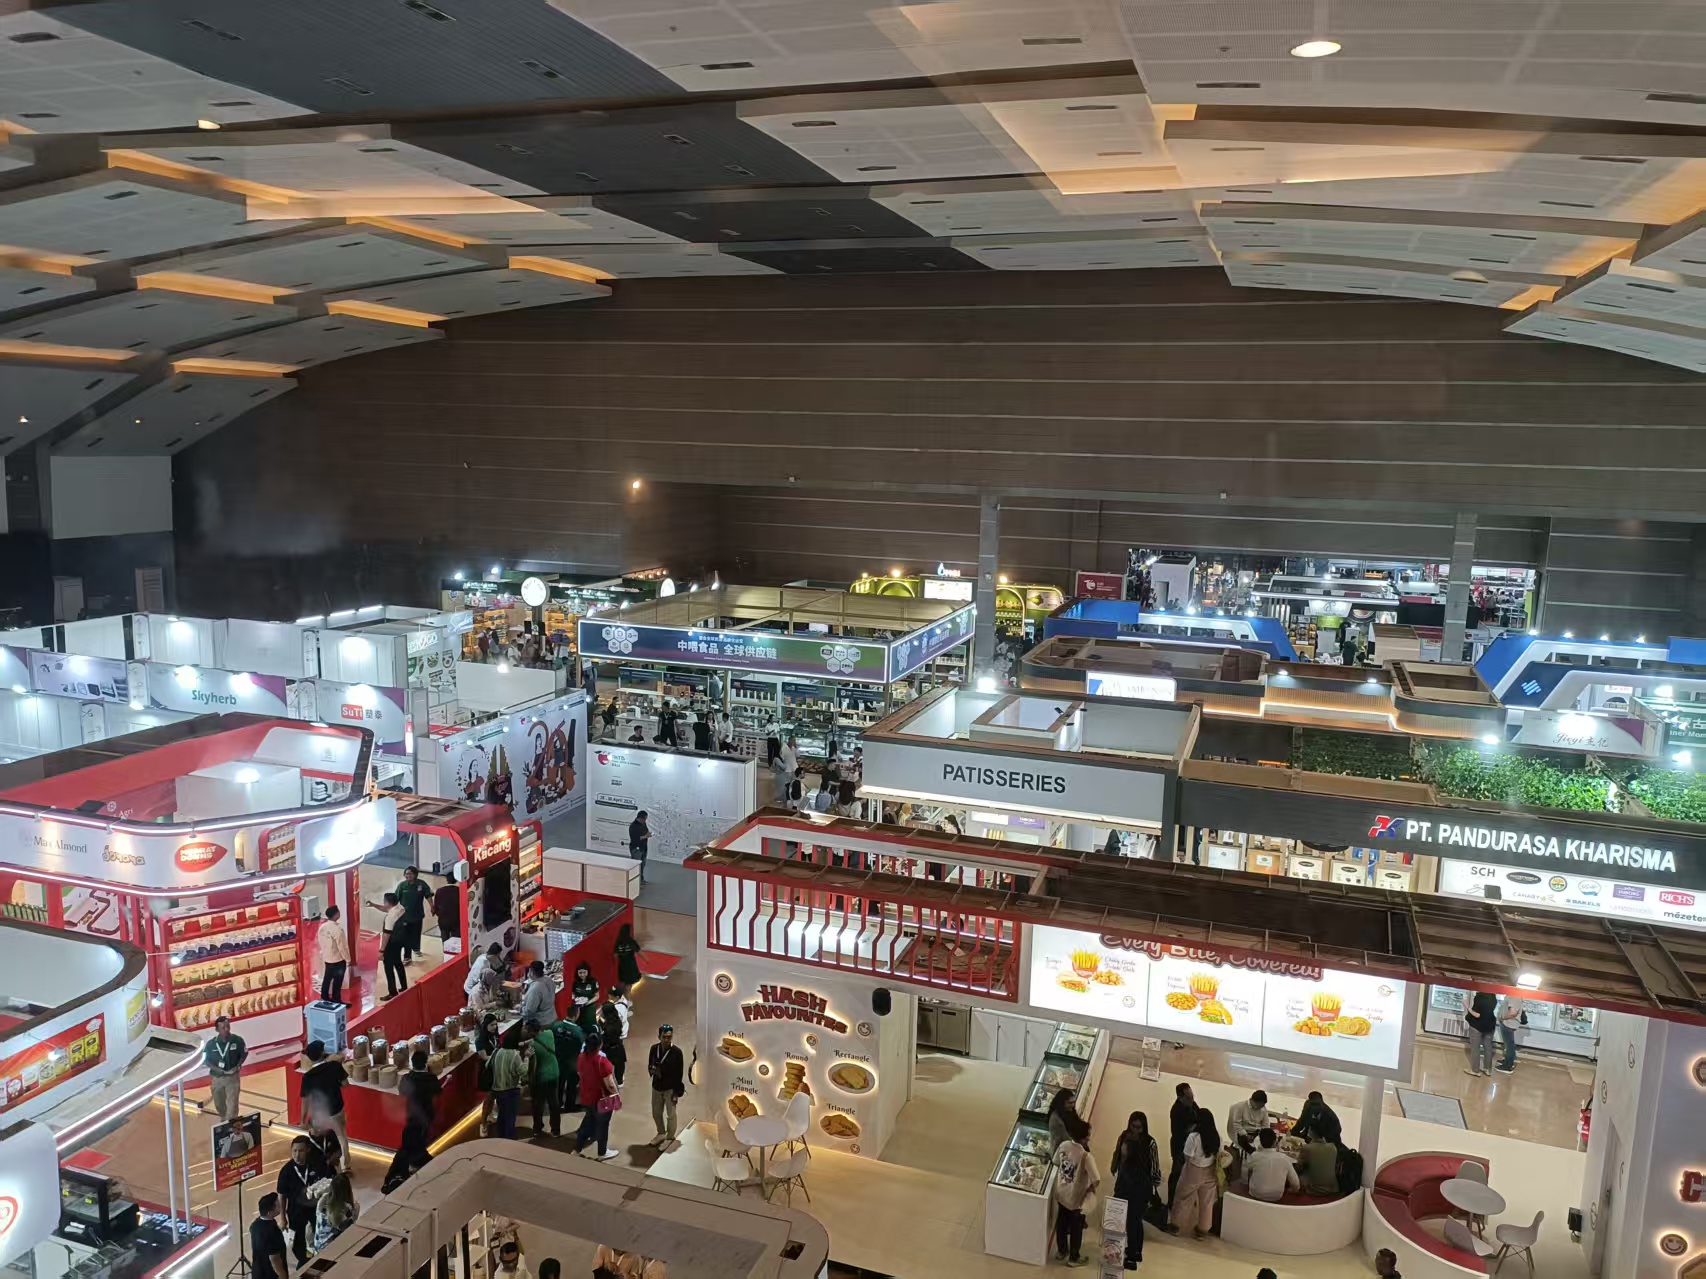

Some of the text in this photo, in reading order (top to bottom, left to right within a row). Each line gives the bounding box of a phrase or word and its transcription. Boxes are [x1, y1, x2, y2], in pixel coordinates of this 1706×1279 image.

[677, 640, 777, 660] 中喂食品 全球供应链
[191, 689, 237, 705] Skyherb
[943, 763, 1066, 794] PATISSERIES
[33, 835, 53, 847] Ma
[1405, 820, 1677, 873] PT. PANDURASA KHARISMA
[474, 838, 511, 864] Kacang
[1471, 866, 1496, 878] SCH
[1661, 892, 1694, 905] RICH'S
[757, 984, 828, 1014] HASH
[741, 1002, 849, 1035] FAVOURITES
[728, 1030, 744, 1039] Oval
[785, 1051, 809, 1062] Round
[834, 1050, 870, 1063] Rectangle
[736, 1076, 753, 1085] Mini
[730, 1083, 759, 1095] Triangle
[827, 1103, 856, 1115] Triangle
